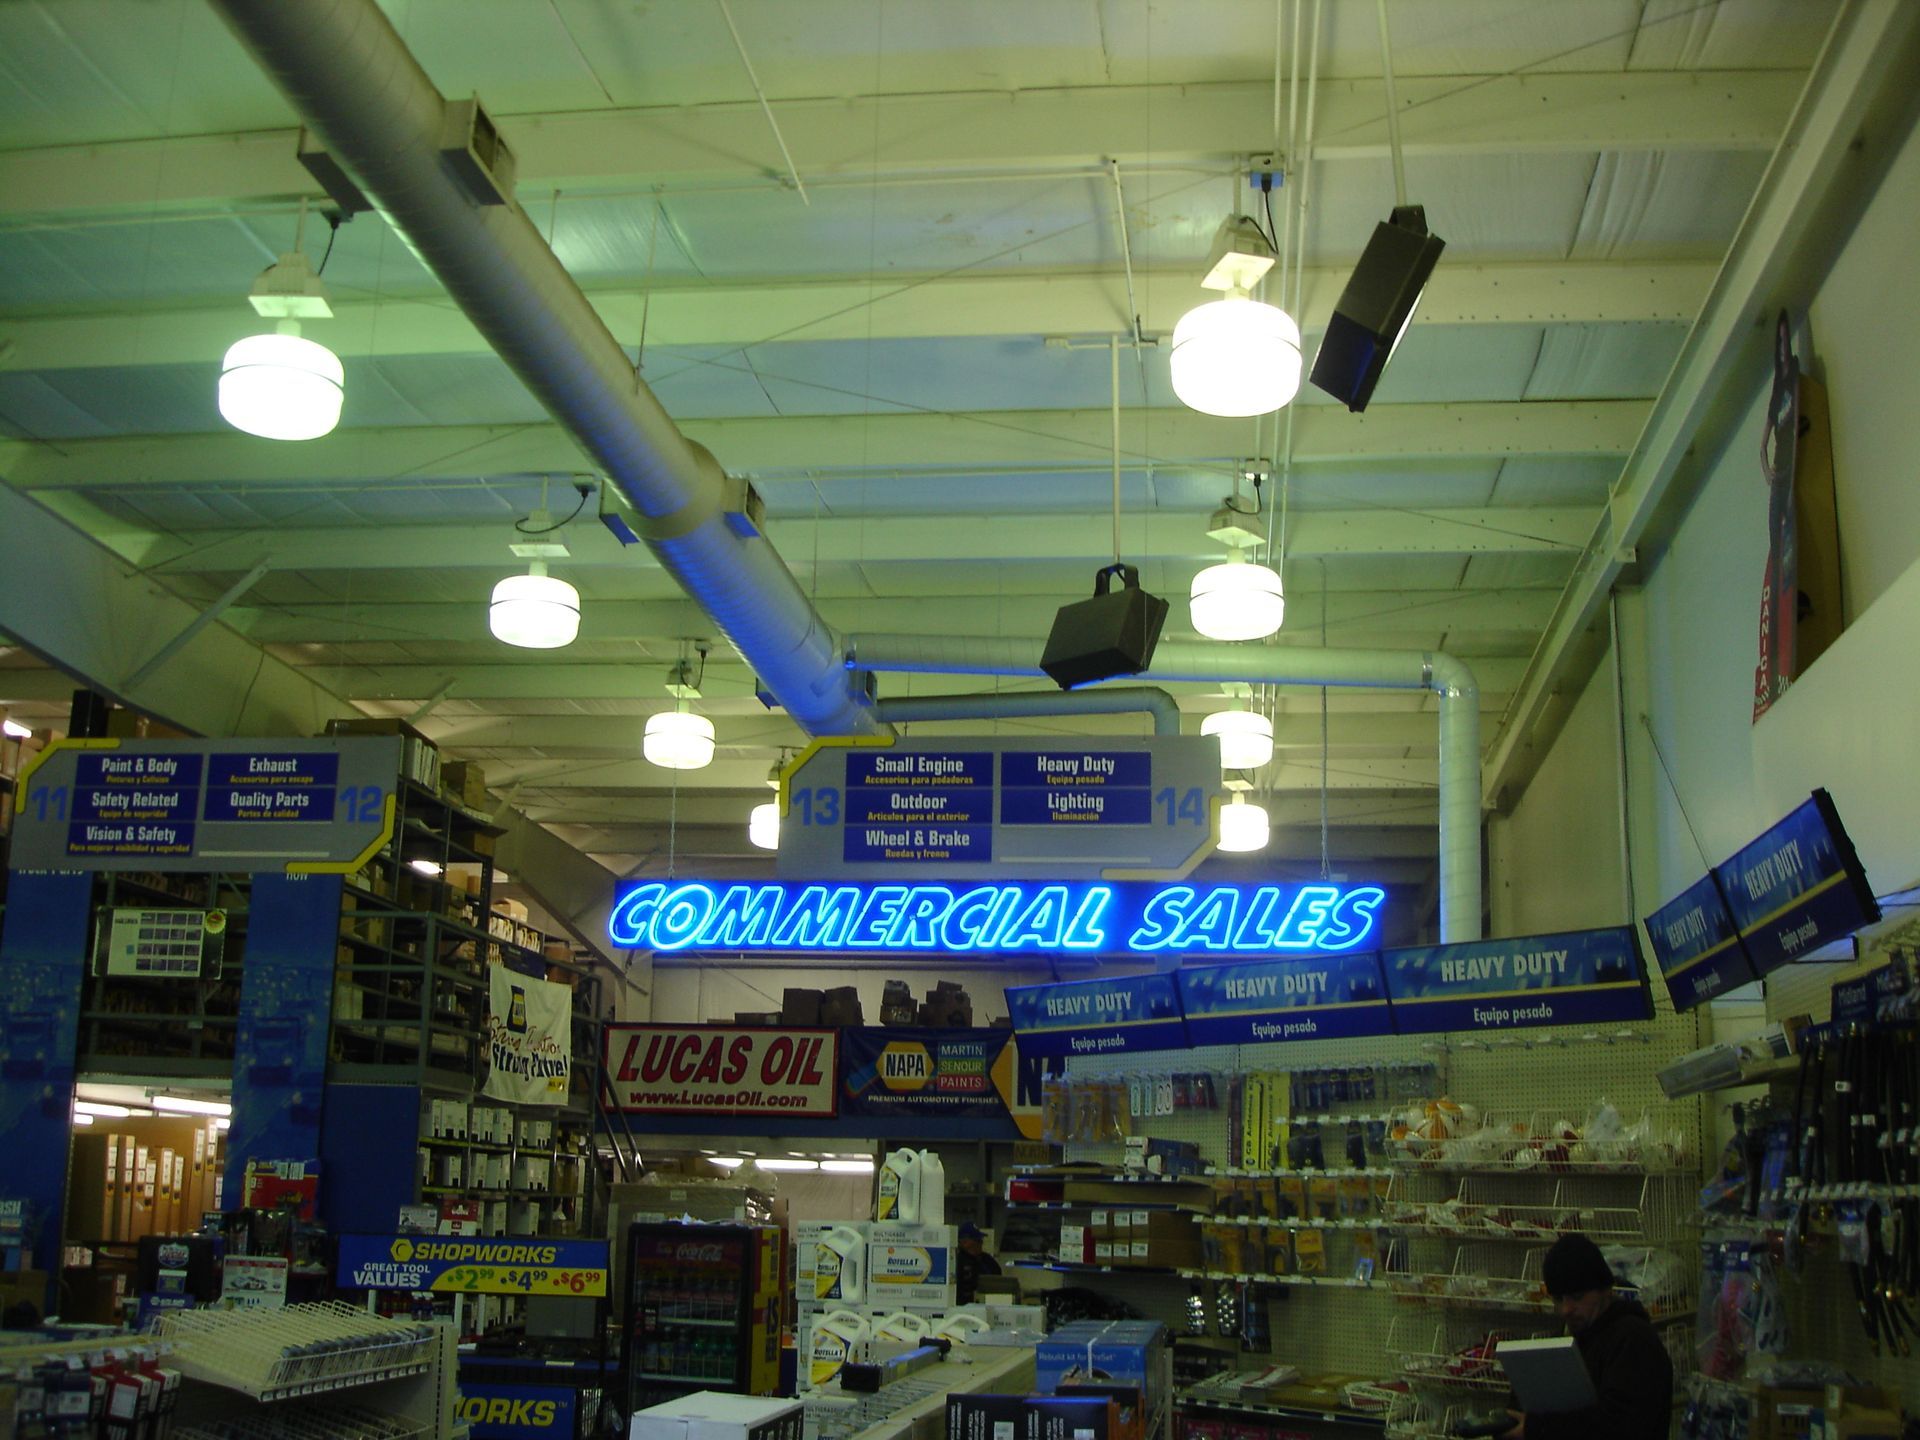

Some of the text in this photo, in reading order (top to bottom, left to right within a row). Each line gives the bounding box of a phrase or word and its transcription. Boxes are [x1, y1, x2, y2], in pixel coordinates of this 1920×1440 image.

[102, 758, 177, 775] Paint & Body
[249, 757, 297, 773] Exhaust
[876, 756, 964, 776] Small Engine
[1037, 756, 1115, 775] Heavy Duty
[865, 775, 909, 784] Accesorios
[911, 777, 929, 785] para
[1046, 774, 1105, 785] Equipo pesado
[31, 786, 68, 821] 11
[92, 792, 178, 809] Safety Related
[230, 791, 309, 810] Quality Parts
[339, 785, 382, 822] 12
[792, 787, 840, 826] 13
[891, 793, 947, 809] Outdoor
[1047, 793, 1104, 813] Lighting
[1155, 787, 1205, 826] 14
[906, 814, 924, 822] para
[926, 812, 935, 821] el
[936, 812, 970, 821] exterior
[86, 826, 176, 844] Vision & Safety
[866, 830, 970, 846] Wheel & Brake
[885, 849, 915, 858] Ruedas
[923, 849, 950, 858] frenos
[1744, 839, 1803, 901] HEAVY DUTY
[609, 883, 1385, 950] COMMERCIAL SALES
[1666, 905, 1708, 951] HEAVY DUTY
[1441, 949, 1568, 983] HEAVY DUTY
[1225, 971, 1328, 999] HEAVY DUTY
[1047, 991, 1132, 1017] HEAVY DUTY
[1473, 1002, 1553, 1026] Equipo pesado
[1252, 1018, 1317, 1038] Equipo pesado
[941, 1045, 983, 1056] MARTIN
[1071, 1033, 1125, 1052] Equipo pesado
[616, 1034, 753, 1085] LUCAS
[760, 1036, 824, 1086] OIL
[886, 1054, 925, 1077] NAPA
[941, 1060, 982, 1071] SENOUR
[940, 1077, 982, 1088] PAINTS
[629, 1089, 808, 1108] www.LucasOil.com
[868, 1095, 905, 1103] PREMIUM
[907, 1096, 960, 1104] AUTOMOTIVE
[415, 1242, 557, 1264] SHOPWORKS
[363, 1262, 431, 1273] GREAT TOOL
[353, 1270, 421, 1288] VALUES
